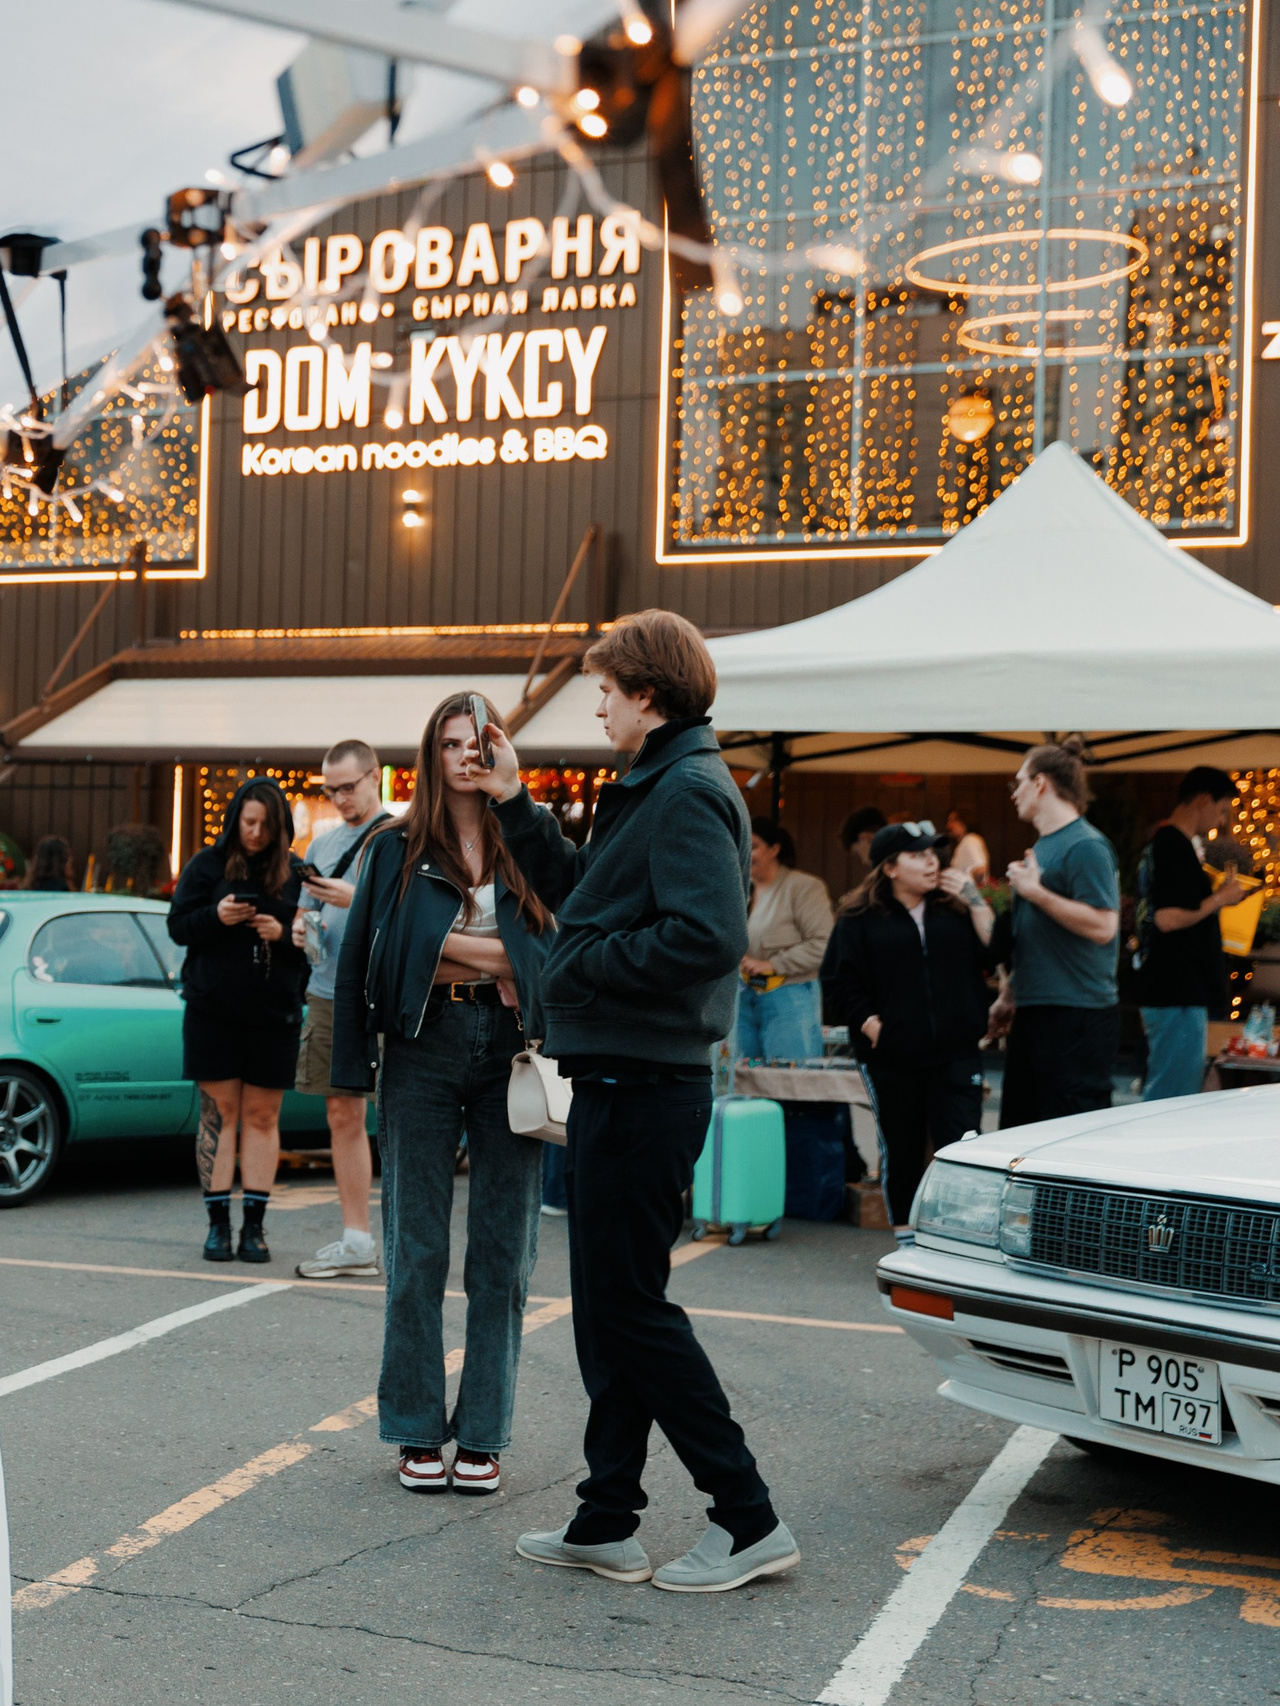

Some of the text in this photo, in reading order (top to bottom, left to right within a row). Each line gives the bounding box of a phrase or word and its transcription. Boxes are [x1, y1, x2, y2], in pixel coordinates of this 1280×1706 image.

[225, 210, 641, 303] СЫРОВАРНЯ
[412, 290, 528, 321] СЫРНАЯ
[541, 282, 636, 313] ЛАВКА
[243, 342, 372, 435] DOM
[242, 424, 608, 476] Korean noodles & BBQ
[1118, 1347, 1199, 1392] P 905
[1114, 1387, 1211, 1428] TM 797
[1179, 1424, 1198, 1437] RUS
